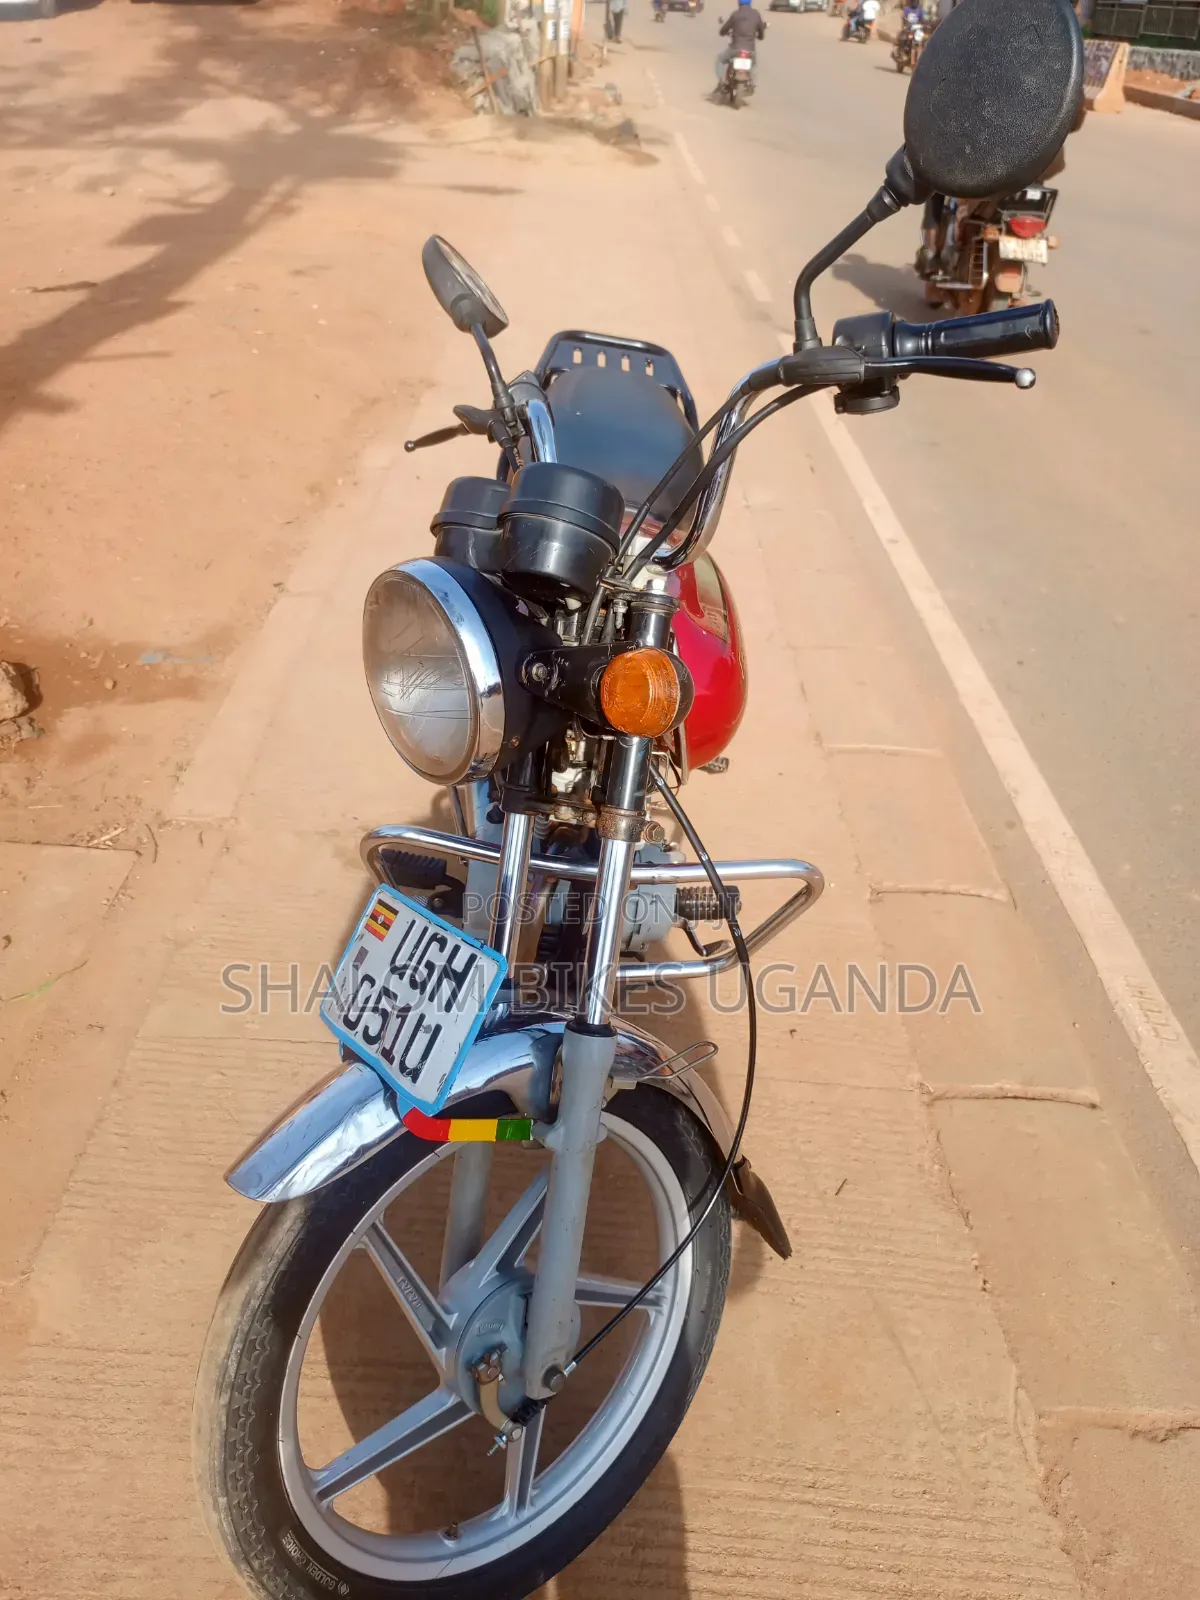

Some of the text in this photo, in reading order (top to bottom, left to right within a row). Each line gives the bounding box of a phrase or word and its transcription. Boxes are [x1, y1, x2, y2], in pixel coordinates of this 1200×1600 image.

[390, 919, 477, 1012] UGH
[342, 973, 443, 1084] 051U
[282, 1533, 336, 1590] GOLDEN CHOICE
